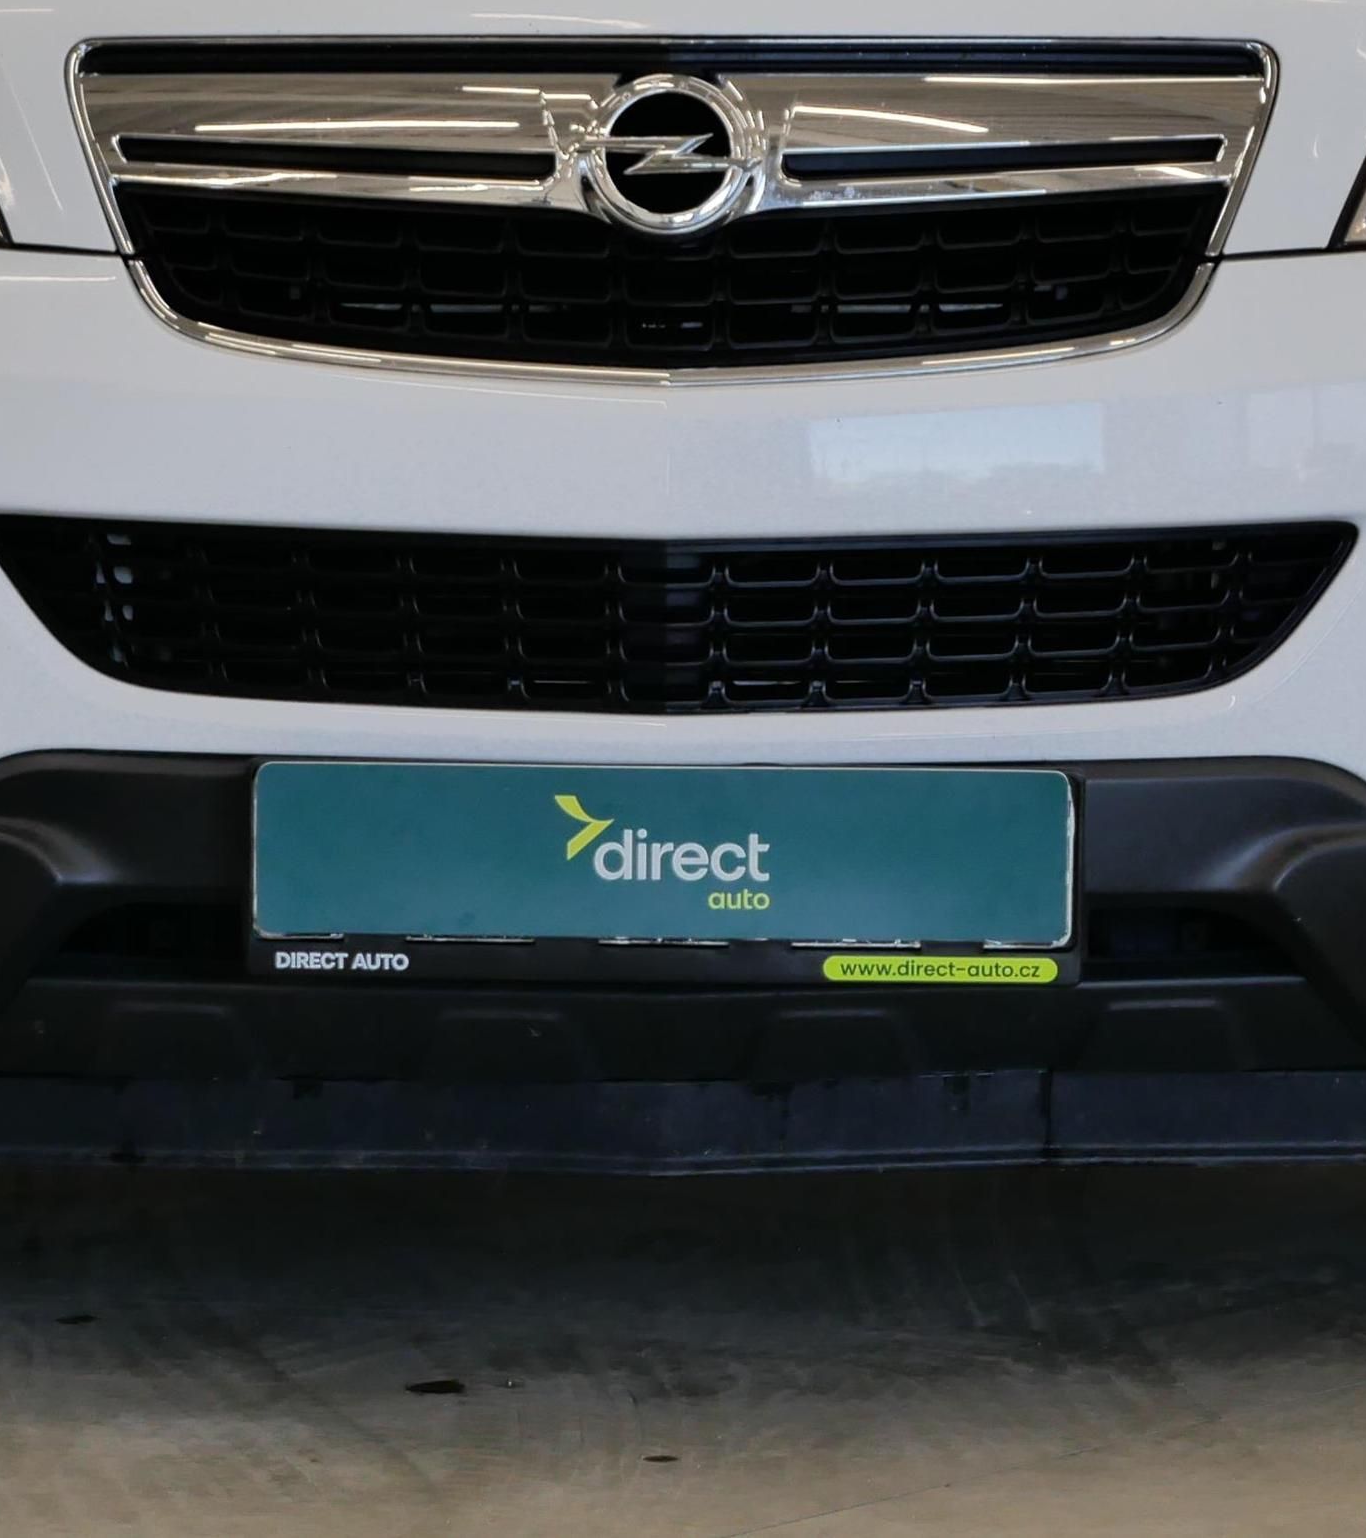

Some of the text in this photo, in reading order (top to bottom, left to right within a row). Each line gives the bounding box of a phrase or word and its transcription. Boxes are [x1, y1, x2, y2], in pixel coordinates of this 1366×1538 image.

[593, 828, 771, 882] direct
[707, 888, 771, 910] auto
[275, 951, 410, 971] DIRECT AUTO
[840, 960, 1041, 978] www.direct-auto.cz
